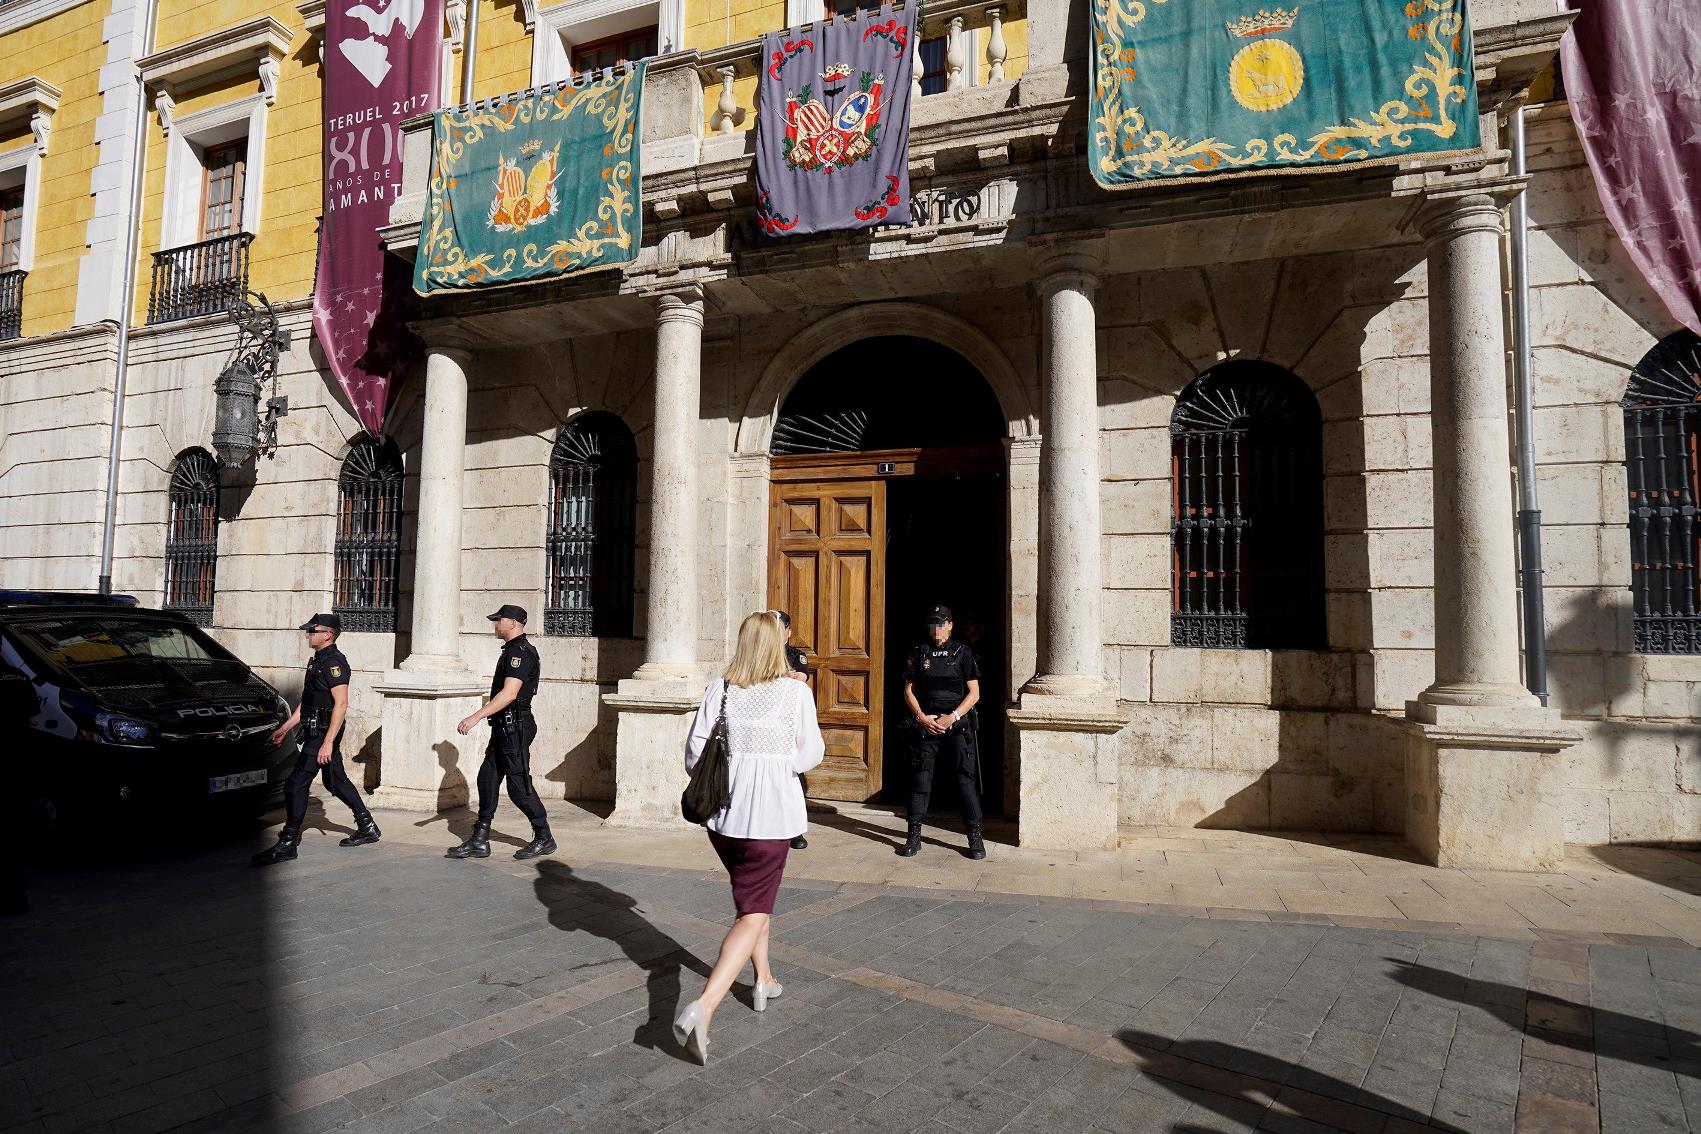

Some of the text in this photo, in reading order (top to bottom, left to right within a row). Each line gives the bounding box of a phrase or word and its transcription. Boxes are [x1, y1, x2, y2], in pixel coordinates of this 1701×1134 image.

[329, 94, 429, 132] TERUEL 2017
[329, 169, 391, 193] AÑOS DE
[176, 704, 261, 719] POLICIA
